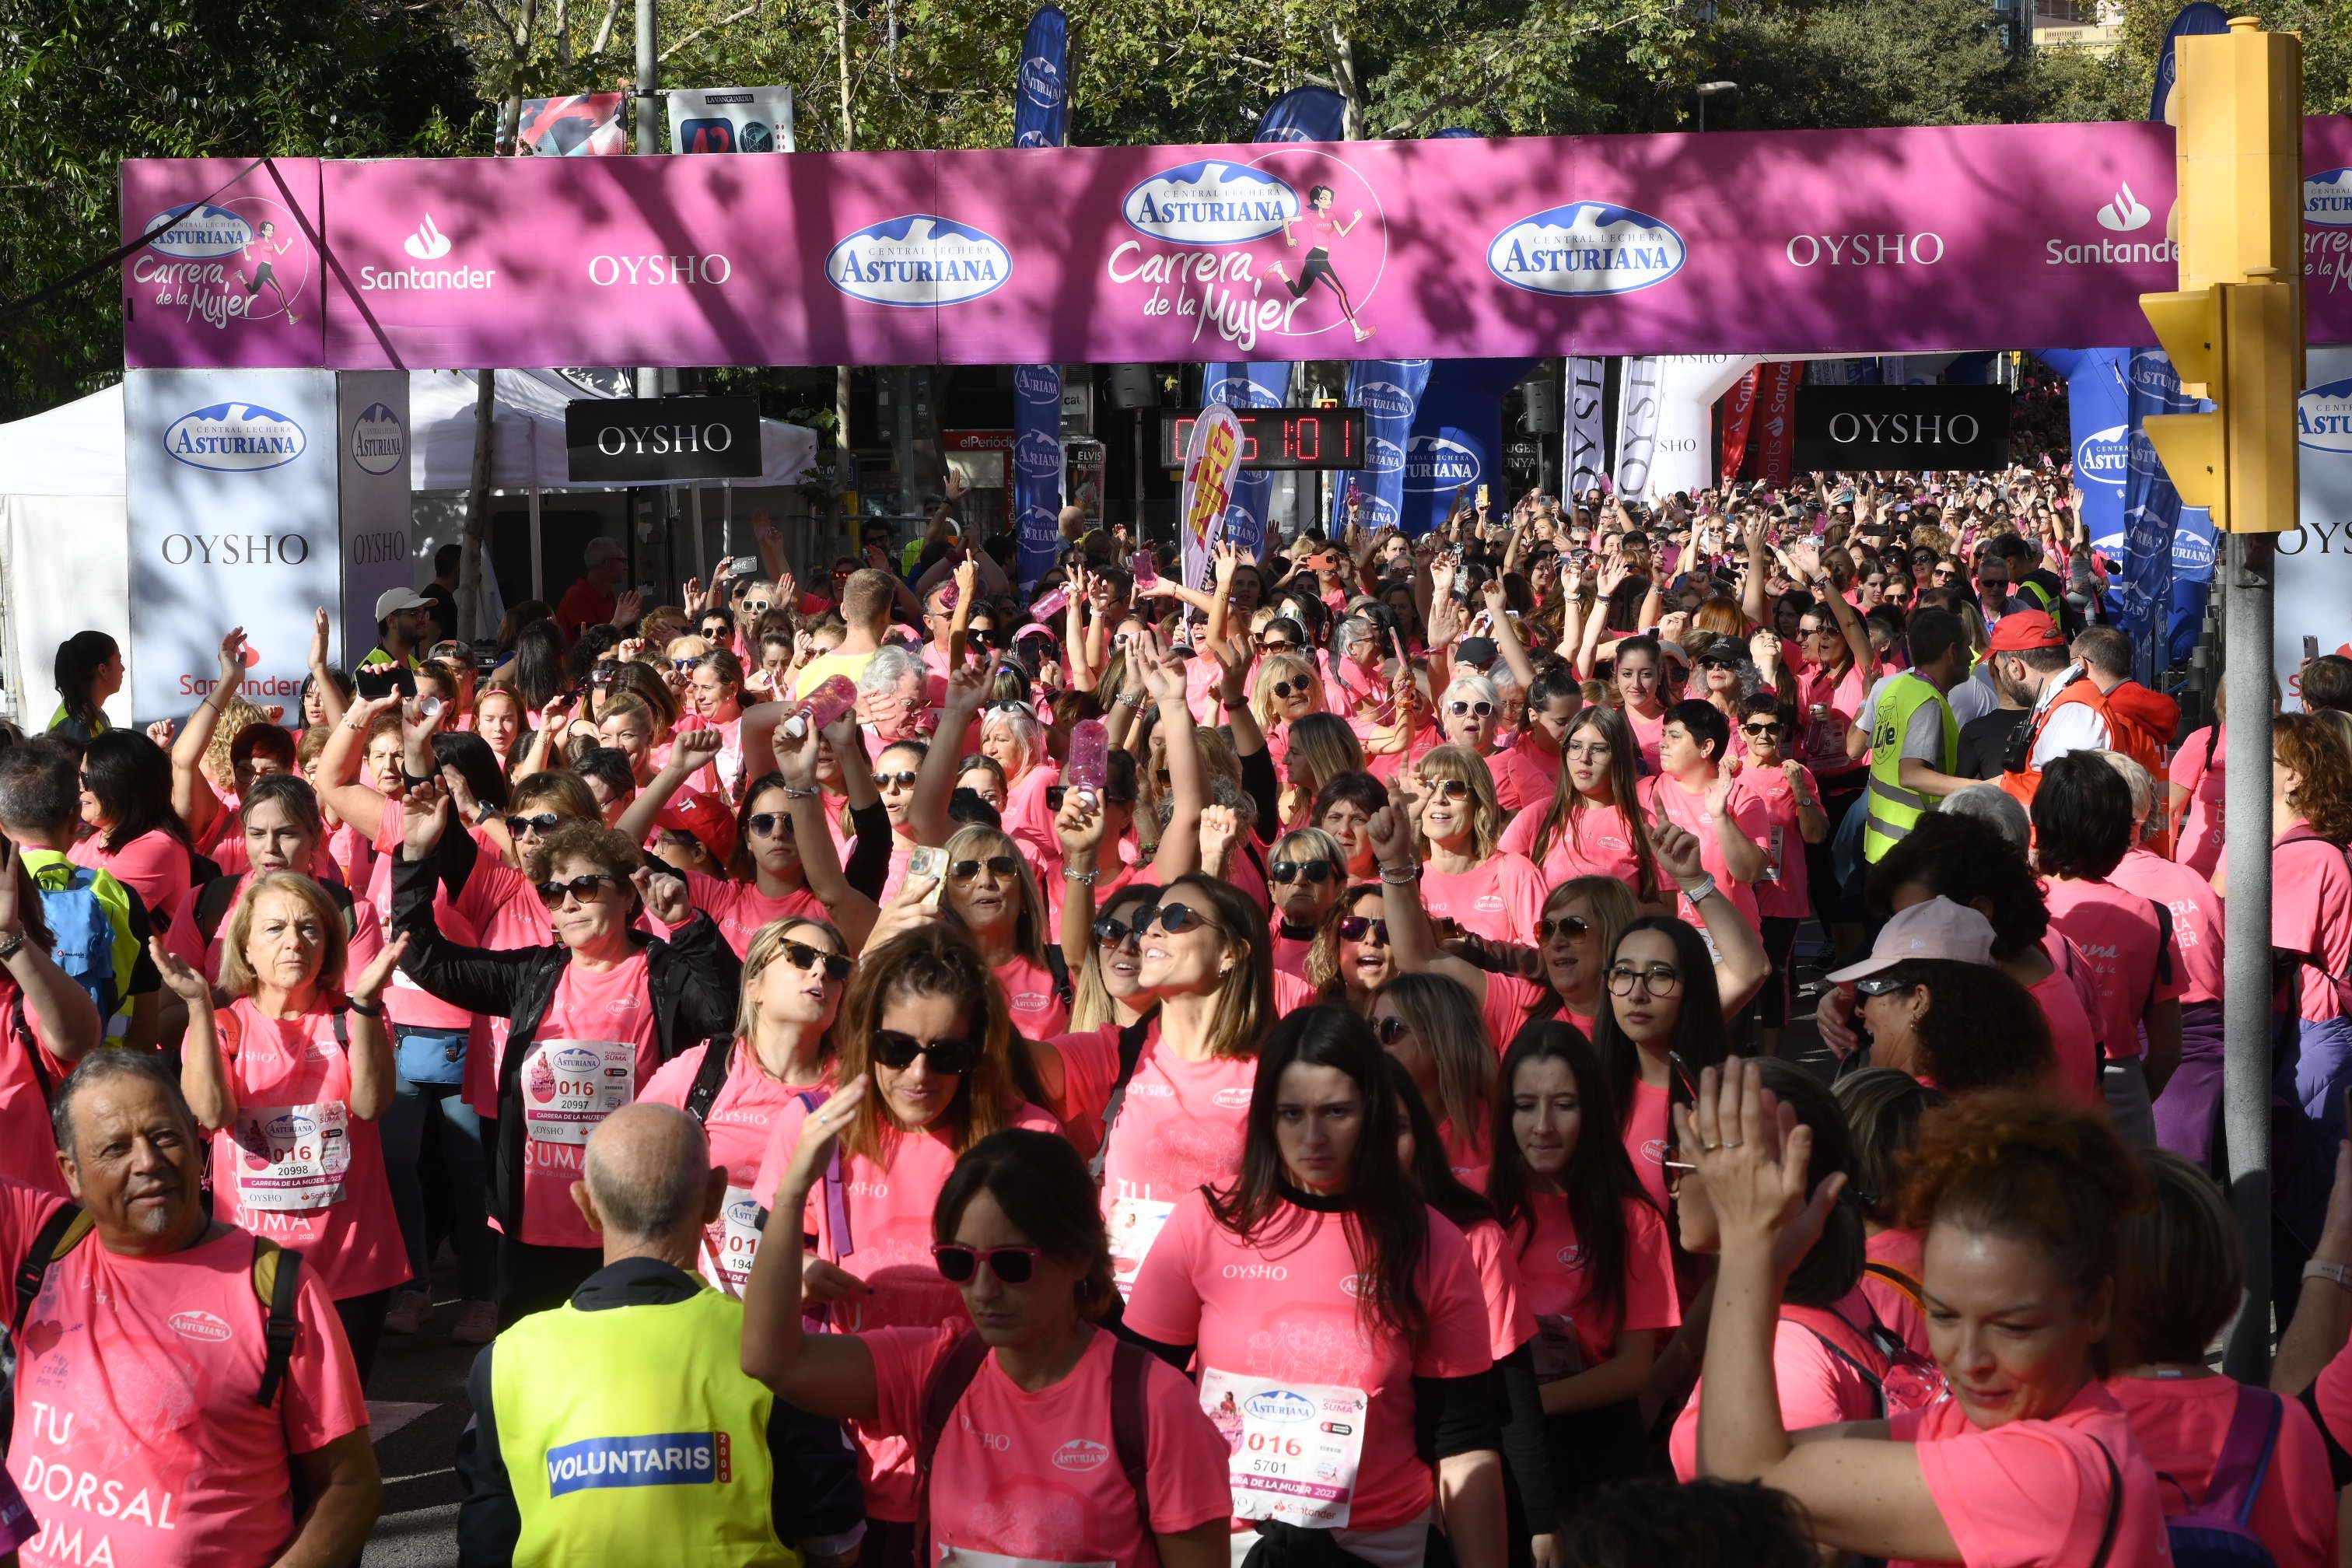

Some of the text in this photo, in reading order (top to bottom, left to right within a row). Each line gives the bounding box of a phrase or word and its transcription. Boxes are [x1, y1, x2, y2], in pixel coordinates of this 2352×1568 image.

[1164, 188, 1282, 198] CENTRAL LECHERA
[1136, 193, 1286, 223] ASTURIANA
[150, 224, 243, 245] ASTURIANA
[1534, 233, 1664, 244] CENTRAL LECHERA
[868, 247, 926, 256] CENTRAL
[1503, 238, 1671, 272] ASTURIANA
[1786, 233, 1944, 267] OYSHO
[134, 254, 225, 285] Carrera
[588, 254, 732, 286] OYSHO
[839, 250, 997, 284] ASTURIANA
[1108, 240, 1253, 285] Carrera
[361, 264, 495, 290] Santander
[156, 281, 259, 330] de la Mujer
[1143, 278, 1307, 352] de la Mujer
[197, 425, 292, 434] CENTRAL LECHERA
[597, 422, 733, 456] OYSHO
[1829, 412, 1979, 445] OYSHO
[175, 428, 296, 454] ASTURIANA
[355, 430, 401, 457] ASTURIANA
[1505, 443, 1538, 453] UGES
[1658, 438, 1696, 453] SHO
[1077, 450, 1101, 461] ELVIS
[161, 534, 310, 565] OYSHO
[353, 530, 405, 565] OYSHO
[180, 673, 303, 698] Sannder
[557, 1057, 597, 1068] ASTURIANA
[559, 1081, 594, 1096] 016
[1128, 1082, 1174, 1097] OYSHO
[562, 1100, 590, 1110] 20997
[320, 1115, 341, 1124] SUMA
[711, 1108, 768, 1125] OYSHO
[536, 1125, 564, 1136] OYSHO
[274, 1146, 312, 1163] 016
[278, 1165, 309, 1176] 20998
[250, 1193, 282, 1202] OYSHO
[235, 1203, 311, 1232] SUMA
[1223, 1264, 1287, 1282] OYSHO
[173, 1317, 228, 1339] ASTURIANA
[1250, 1401, 1310, 1417] ASTURIANA
[1323, 1402, 1353, 1414] SUMA
[32, 1401, 74, 1445] TU
[1248, 1433, 1303, 1456] 016
[548, 1447, 711, 1484] VOLUNTARIS
[719, 1434, 728, 1482] 2000
[1253, 1459, 1287, 1475] 5701
[22, 1455, 175, 1530] DORSAL
[1251, 1479, 1264, 1487] DE
[1265, 1479, 1278, 1489] LA
[1278, 1482, 1312, 1494] MUJER
[1314, 1487, 1337, 1498] 2023
[1286, 1503, 1336, 1520] Santander
[30, 1517, 115, 1568] UMA
